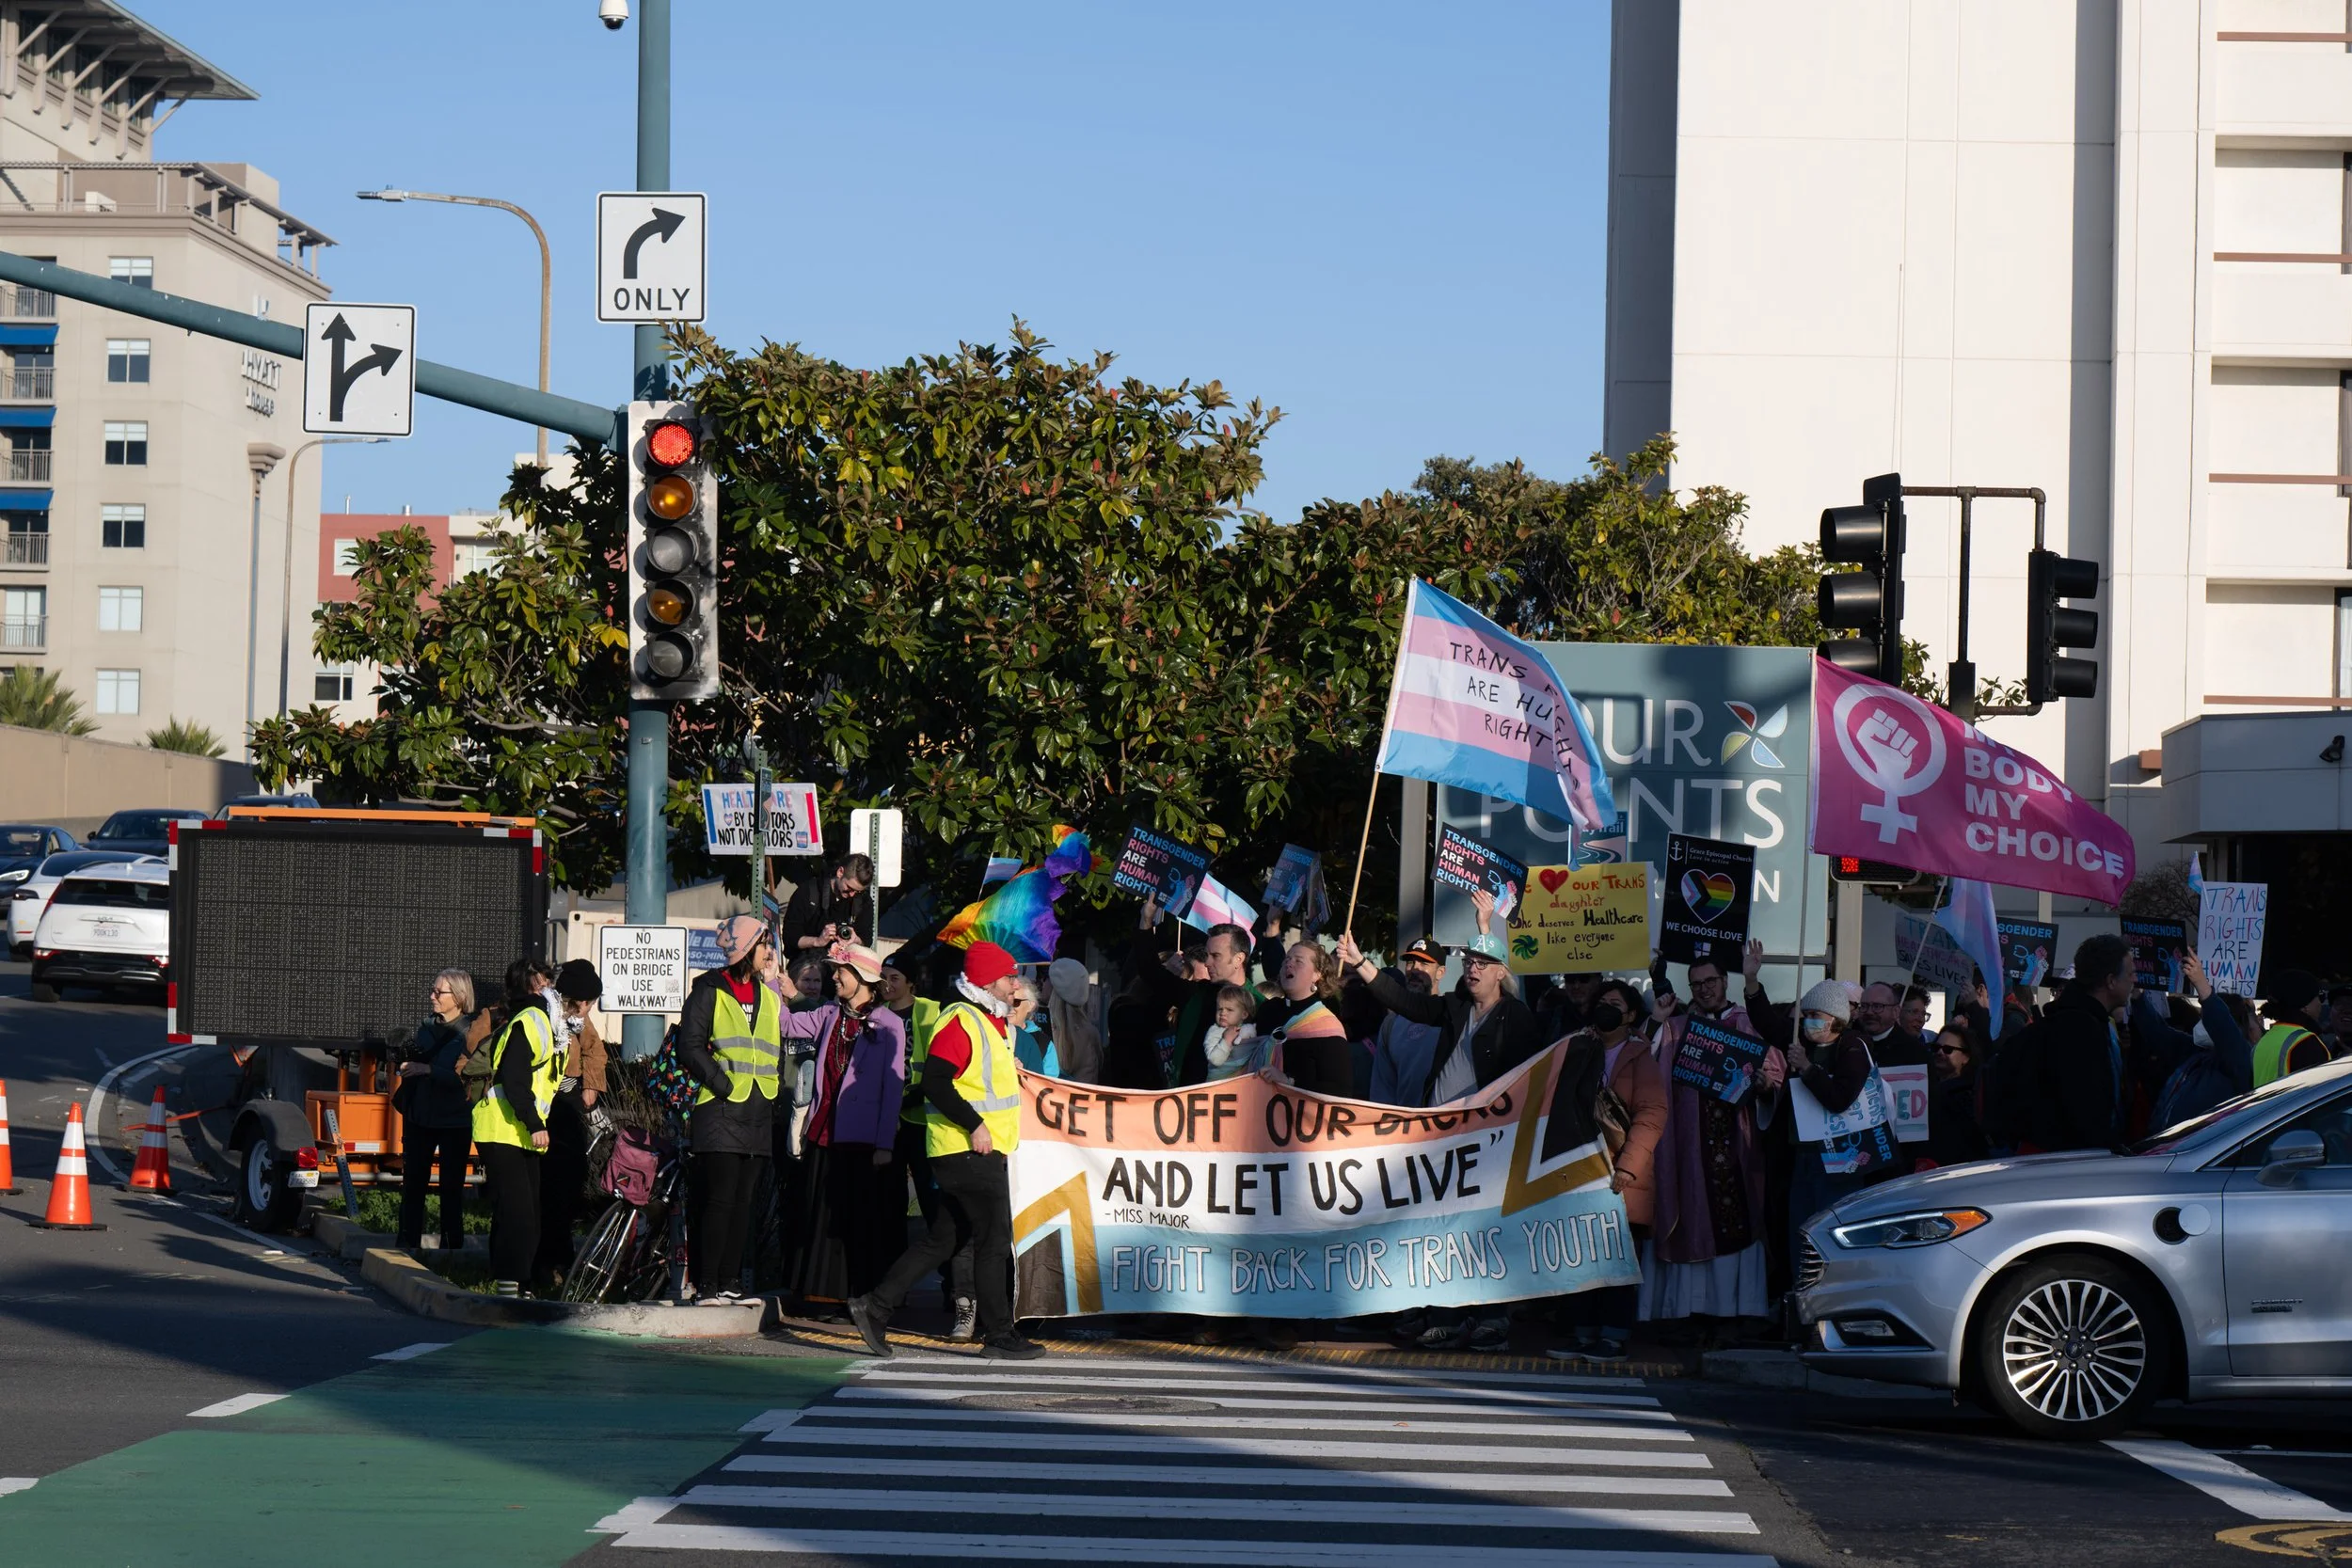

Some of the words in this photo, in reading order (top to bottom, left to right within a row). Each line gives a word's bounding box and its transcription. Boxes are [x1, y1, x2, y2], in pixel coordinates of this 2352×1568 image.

[614, 287, 691, 311] ONLY
[242, 348, 281, 390] HYATT
[246, 385, 275, 417] house
[1450, 641, 1527, 678] TRANS
[1467, 676, 1500, 703] ARE
[1485, 713, 1552, 749] RIGHT
[1964, 747, 2073, 803] BODY
[1964, 784, 2028, 820] MY
[734, 812, 745, 827] BY
[748, 812, 795, 830] DTORS
[718, 828, 735, 846] NOT
[1133, 827, 1205, 868] TRANSGENDER
[1123, 850, 1147, 867] ARE
[1128, 838, 1169, 864] RIGHTS
[1440, 849, 1464, 866] ARE
[1442, 839, 1485, 865] RIGHTS
[1446, 829, 1523, 878] TRANSGENDER
[1964, 821, 2124, 879] CHOICE
[1119, 861, 1160, 886] HUMAN
[1437, 867, 1479, 893] RIGHTS
[1438, 858, 1480, 884] HUMAN
[1114, 871, 1157, 895] RIGHTS
[1573, 880, 1599, 891] OUR
[1602, 873, 1645, 890] TRANS
[1549, 895, 1605, 913] daughter
[2206, 887, 2266, 912] TRANS
[1538, 913, 1574, 928] deserves
[1583, 908, 1644, 927] Healthcare
[2204, 914, 2264, 941] RIGHTS
[636, 932, 651, 944] NO
[1547, 932, 1566, 944] like
[1574, 932, 1615, 948] everyone
[1666, 921, 1679, 931] WE
[1681, 924, 1718, 938] CHOOSE
[1719, 930, 1742, 942] LOVE
[1997, 923, 2053, 939] SGENDER
[2122, 921, 2183, 938] TRANSGENDER
[606, 947, 680, 960] PEDESTRIANS
[1470, 934, 1495, 953] A's
[1567, 947, 1593, 960] else
[2212, 942, 2249, 960] ARE
[612, 963, 628, 975] ON
[633, 964, 674, 976] BRIDGE
[2201, 960, 2256, 980] HUMAN
[631, 979, 654, 991] USE
[2206, 978, 2255, 997] IGHTS
[617, 995, 667, 1007] WALKWAY
[1685, 1033, 1724, 1054] RIGHTS
[1691, 1022, 1764, 1055] TRANSGENDER
[1680, 1044, 1703, 1059] ARE
[1677, 1054, 1715, 1077] HUMAN
[1672, 1066, 1710, 1087] RIGHTS
[1153, 1093, 1237, 1145] OFF
[1265, 1093, 1357, 1147] OUR
[1102, 1157, 1192, 1208] AND
[1207, 1163, 1289, 1216] LET
[1309, 1158, 1363, 1215] US
[1150, 1212, 1190, 1229] MAJOR
[1111, 1244, 1211, 1292] FIGHT
[1231, 1247, 1315, 1294] BACK
[1324, 1237, 1392, 1291] FOR
[1398, 1226, 1507, 1288] TRANS
[1520, 1209, 1625, 1274] YOUTH
